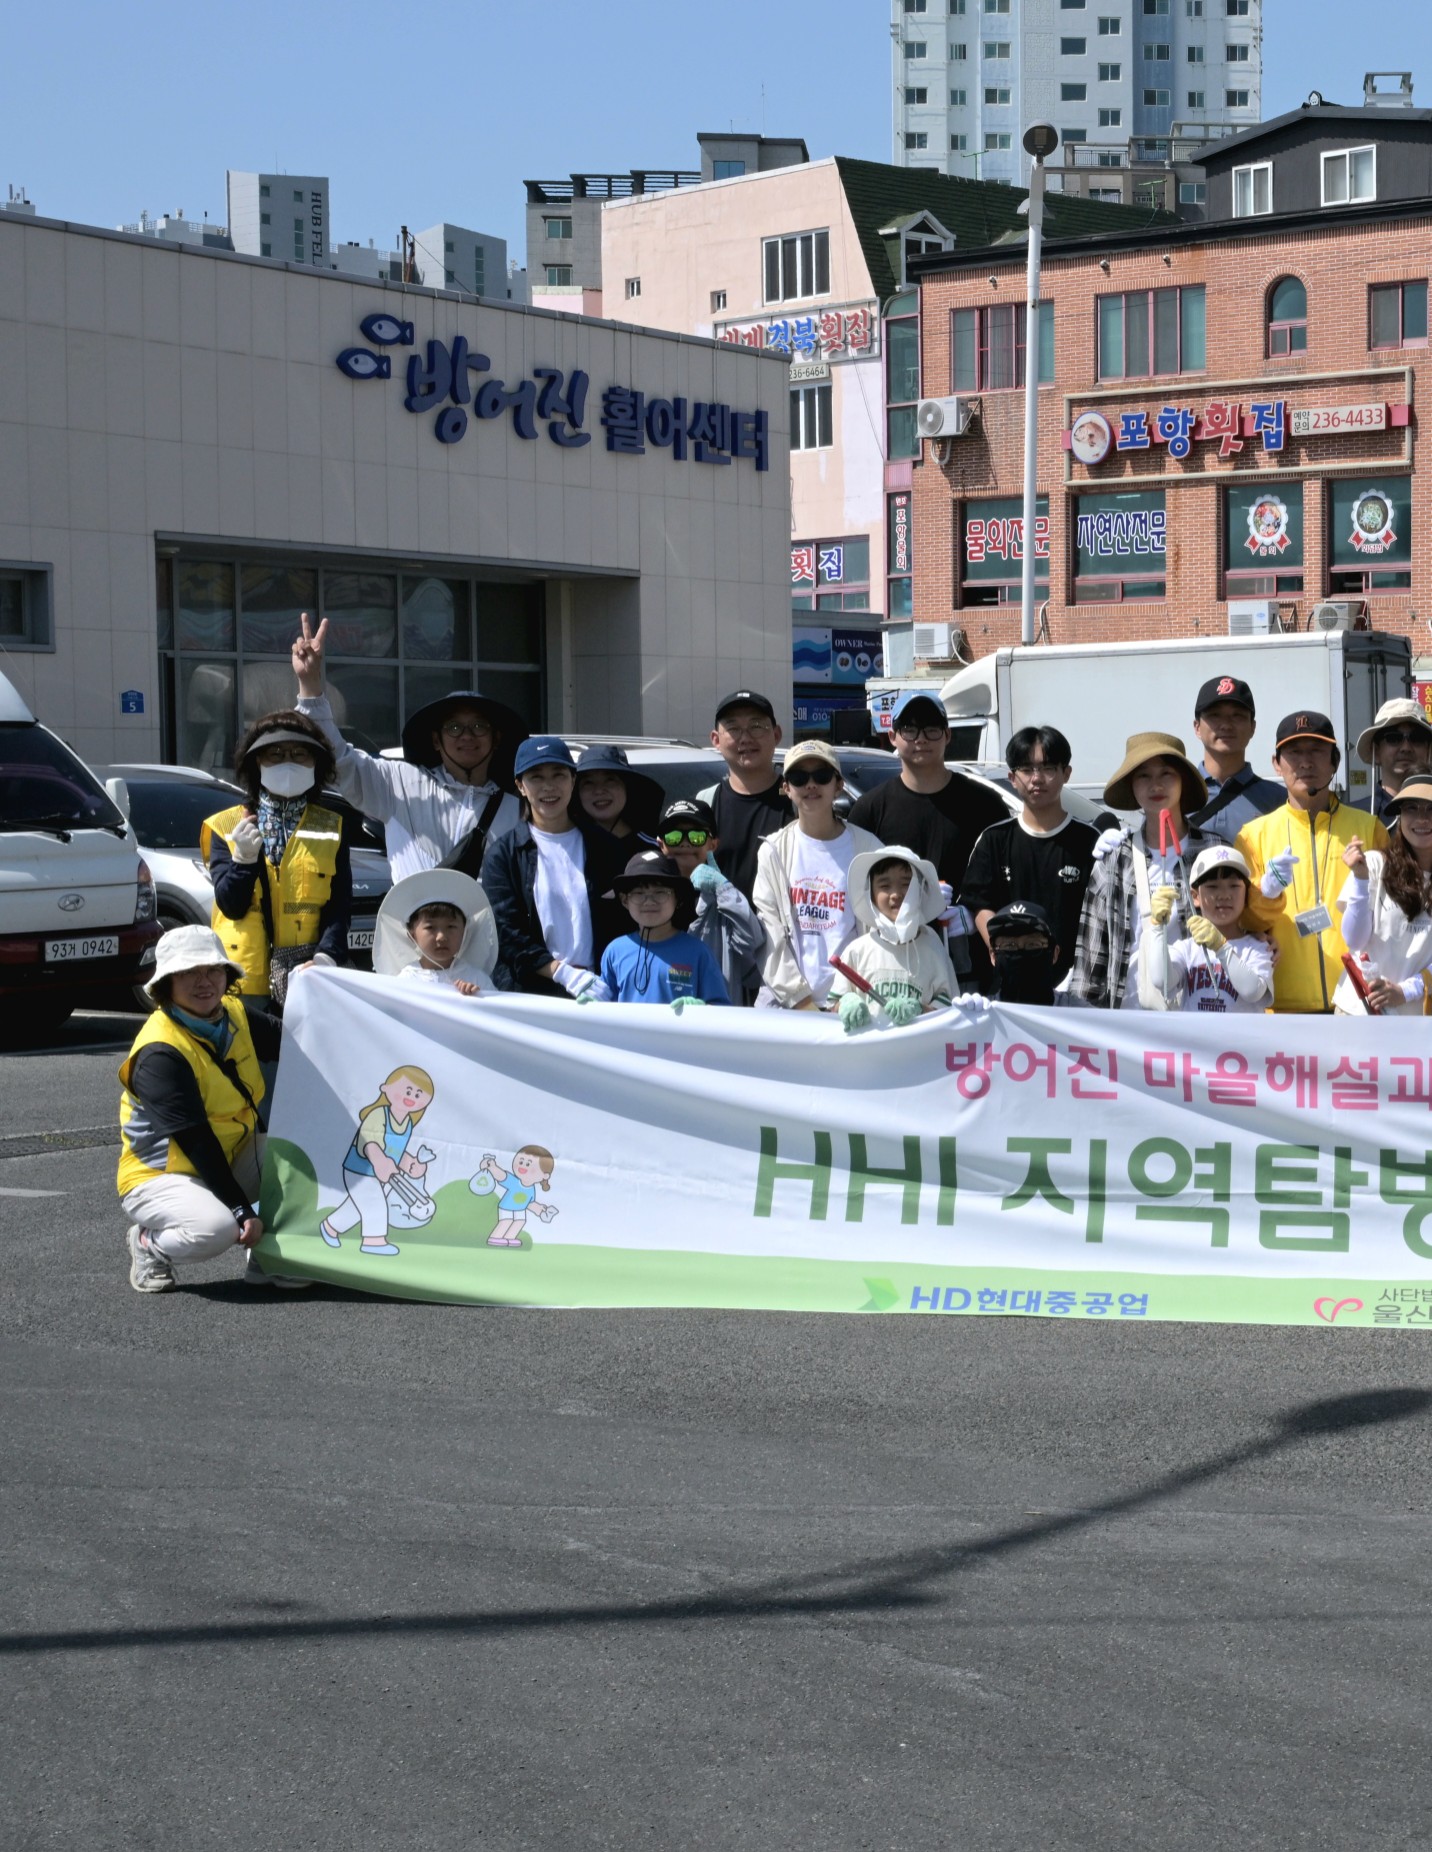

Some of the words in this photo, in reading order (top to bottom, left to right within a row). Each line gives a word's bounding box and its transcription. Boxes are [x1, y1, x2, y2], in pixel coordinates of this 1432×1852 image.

[404, 335, 592, 447] 방어진
[600, 386, 769, 471] 활어센터
[1312, 408, 1383, 429] 236-4433
[1116, 401, 1286, 459] 포항횟집
[1077, 510, 1167, 556] 자연산전문
[834, 638, 863, 648] OWNER
[130, 701, 136, 712] 5
[82, 939, 113, 956] 0942
[945, 1041, 1118, 1100] 방어진
[753, 1125, 958, 1227] HHI
[910, 1285, 1148, 1316] HD현대중공업
